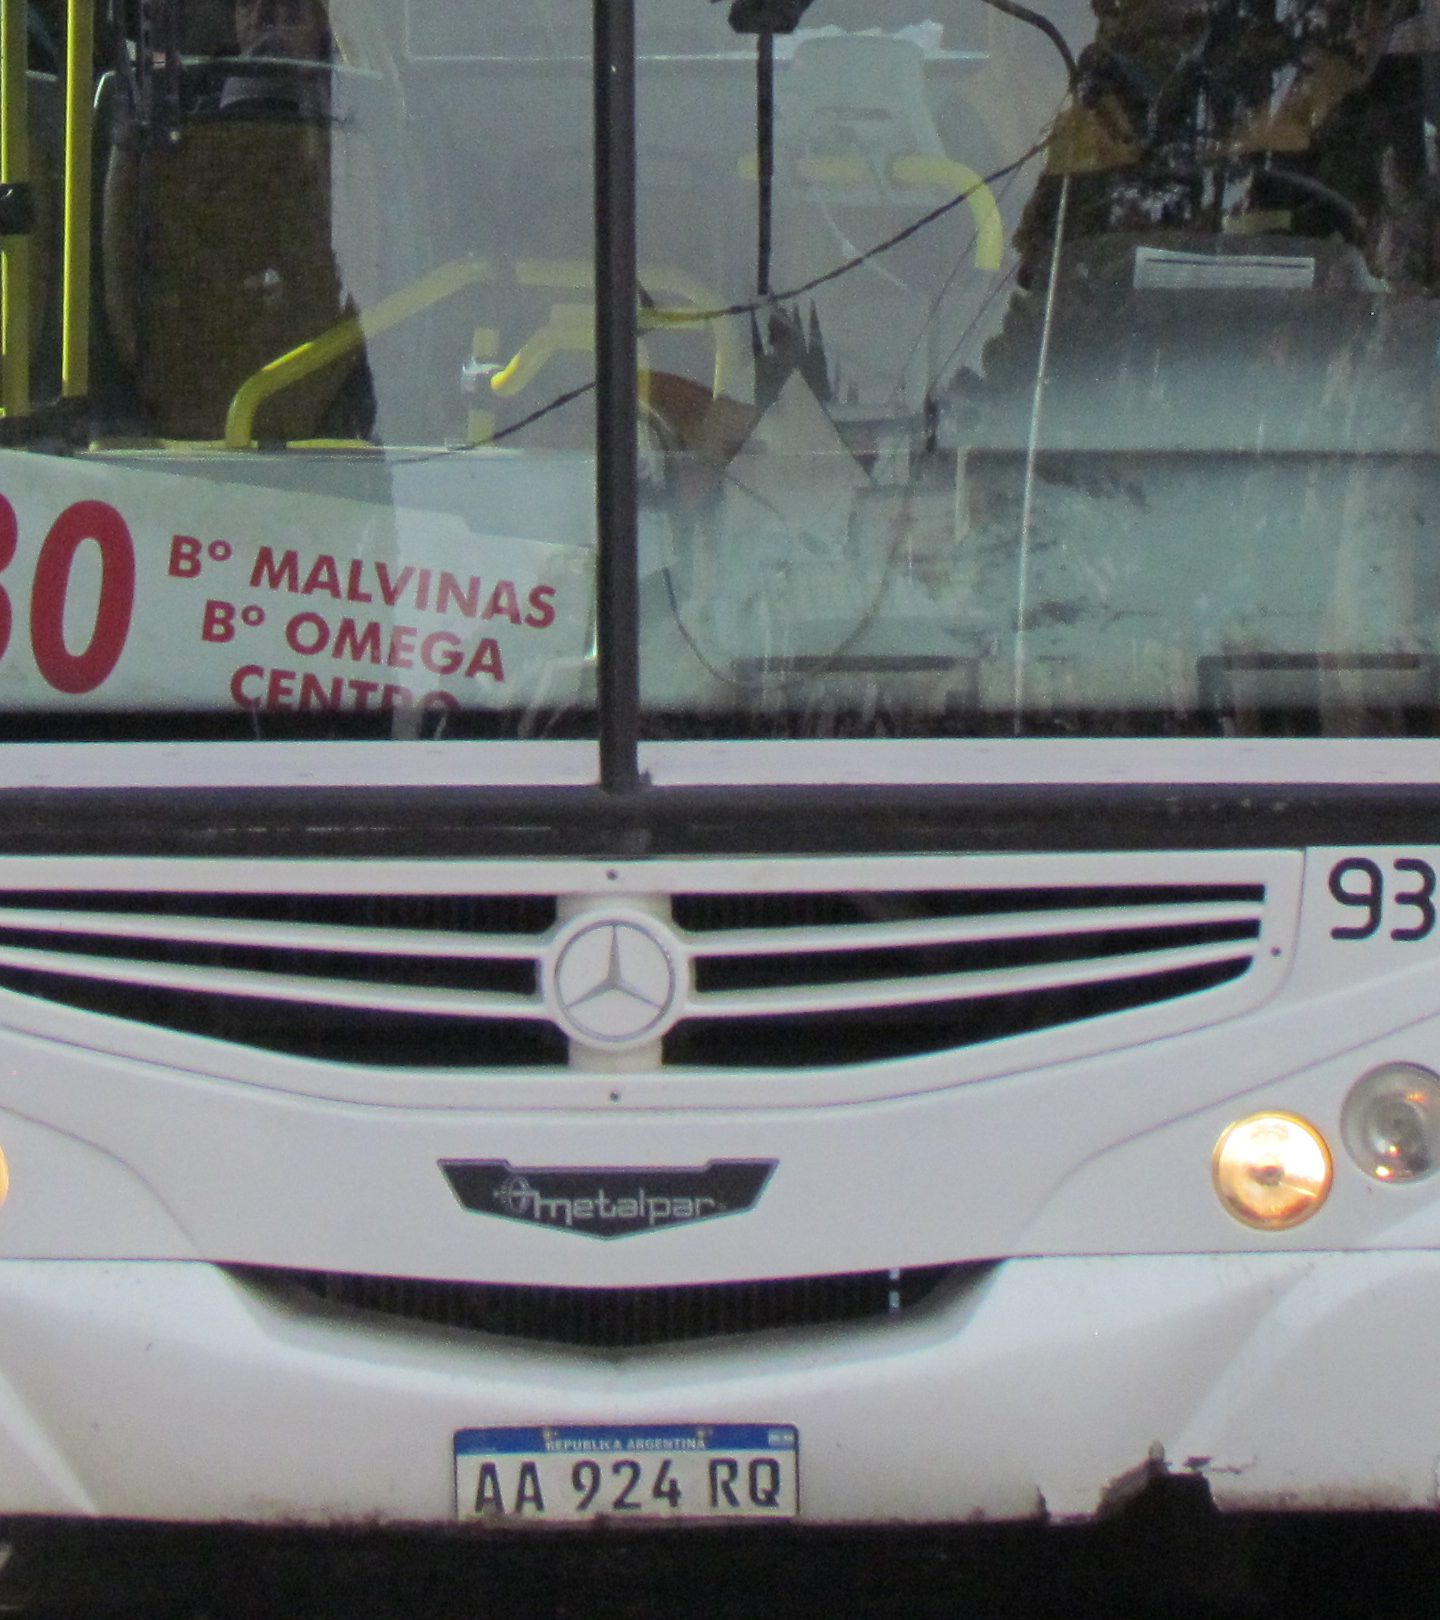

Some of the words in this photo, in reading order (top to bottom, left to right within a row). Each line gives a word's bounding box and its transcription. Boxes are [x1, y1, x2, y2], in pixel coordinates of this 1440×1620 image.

[250, 545, 556, 629] MALVINAS
[285, 611, 505, 682] OMEGA
[1328, 857, 1436, 941] 93
[533, 1188, 715, 1227] metalpar
[627, 1438, 706, 1450] ARGENTINA
[475, 1462, 544, 1513] AA
[571, 1458, 682, 1511] 924
[710, 1457, 780, 1507] RQ
